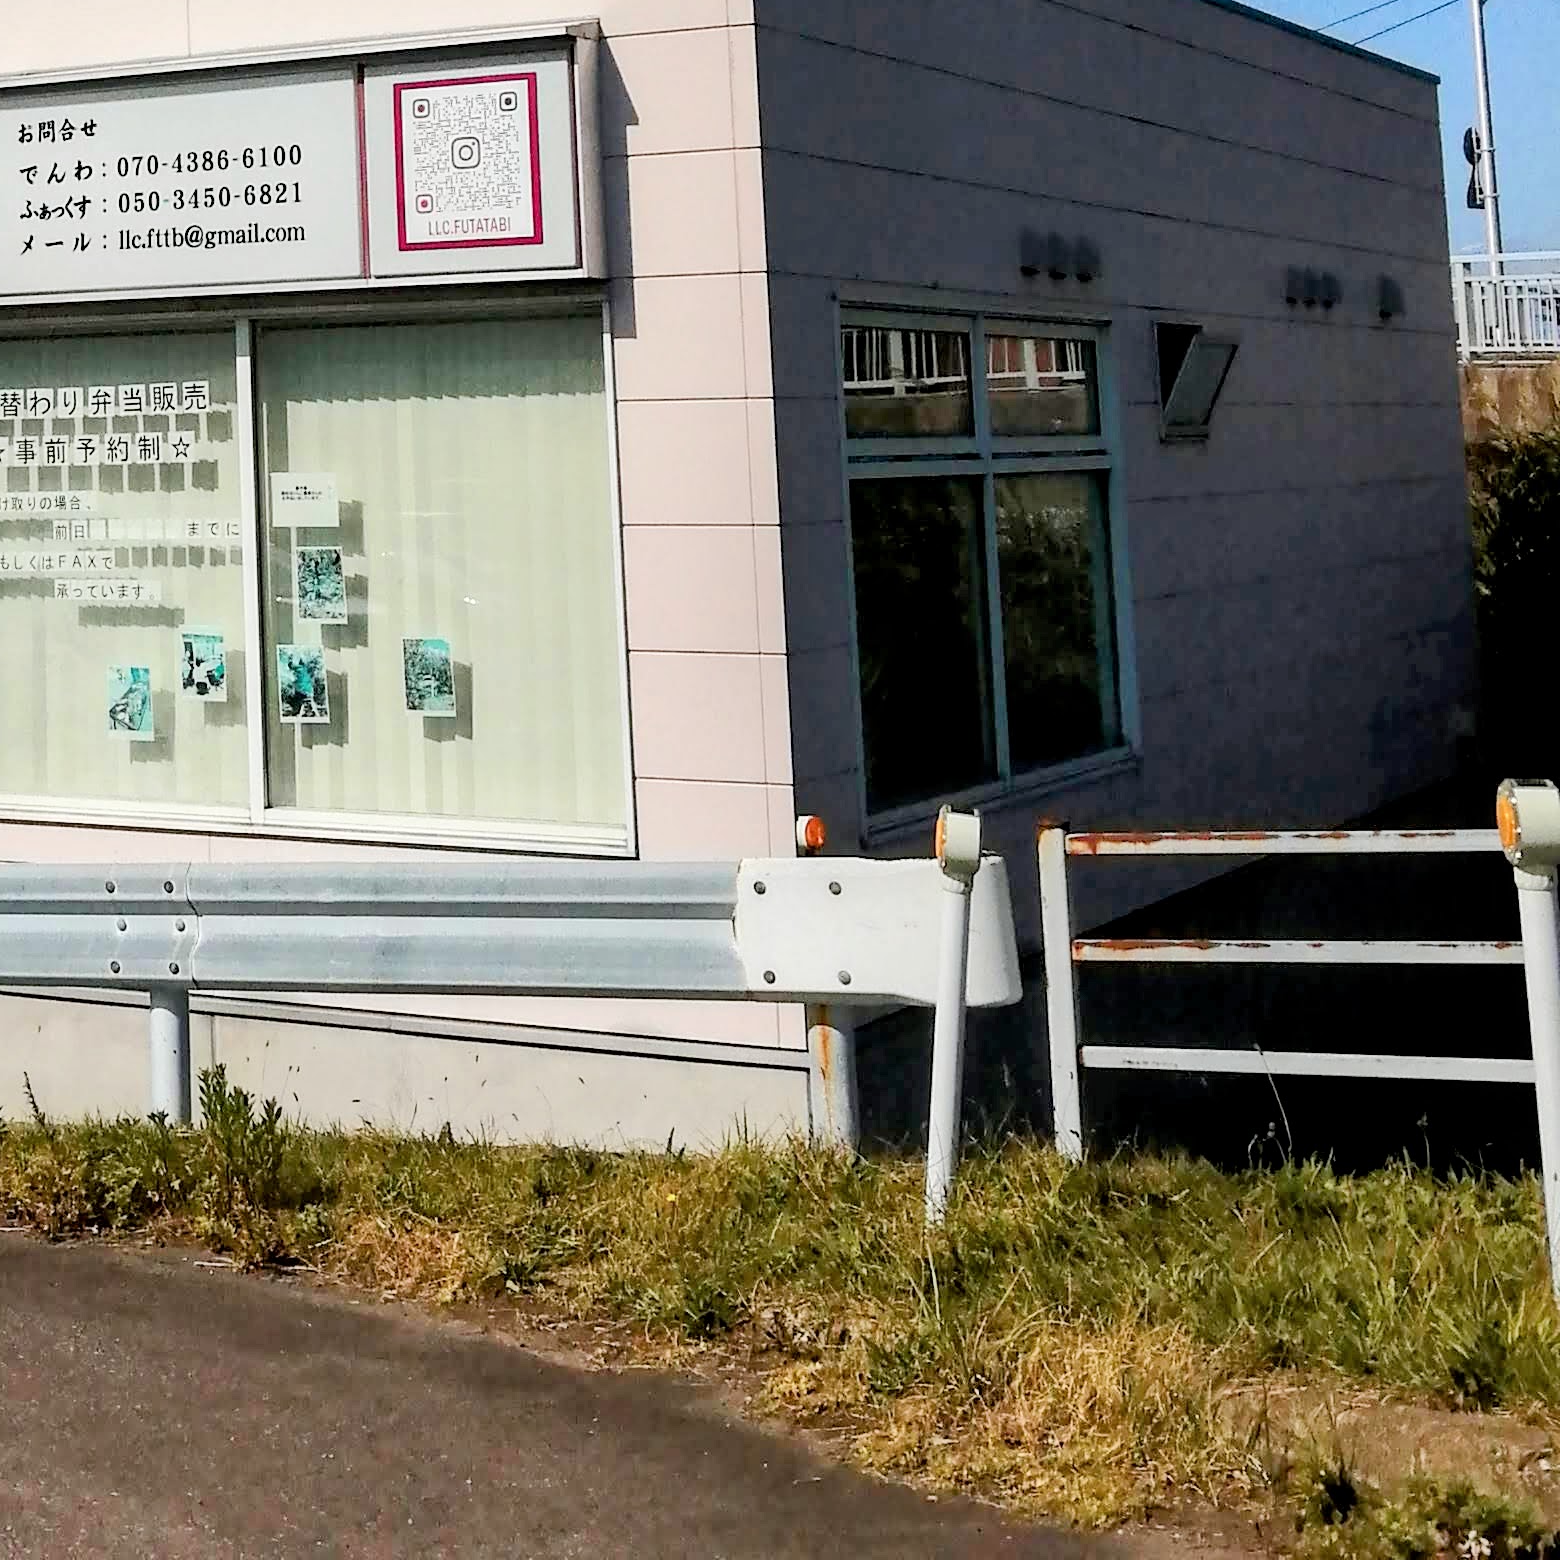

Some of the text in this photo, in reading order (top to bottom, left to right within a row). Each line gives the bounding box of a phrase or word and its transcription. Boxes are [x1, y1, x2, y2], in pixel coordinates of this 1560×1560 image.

[18, 118, 98, 143] お問合せ
[117, 144, 303, 178] 070-4386-6100
[118, 181, 303, 214] 050-3450-6821
[118, 222, 306, 252] llc.fttb@gmail.com
[428, 216, 512, 236] LLC.FUTATABI
[187, 522, 240, 537] までに
